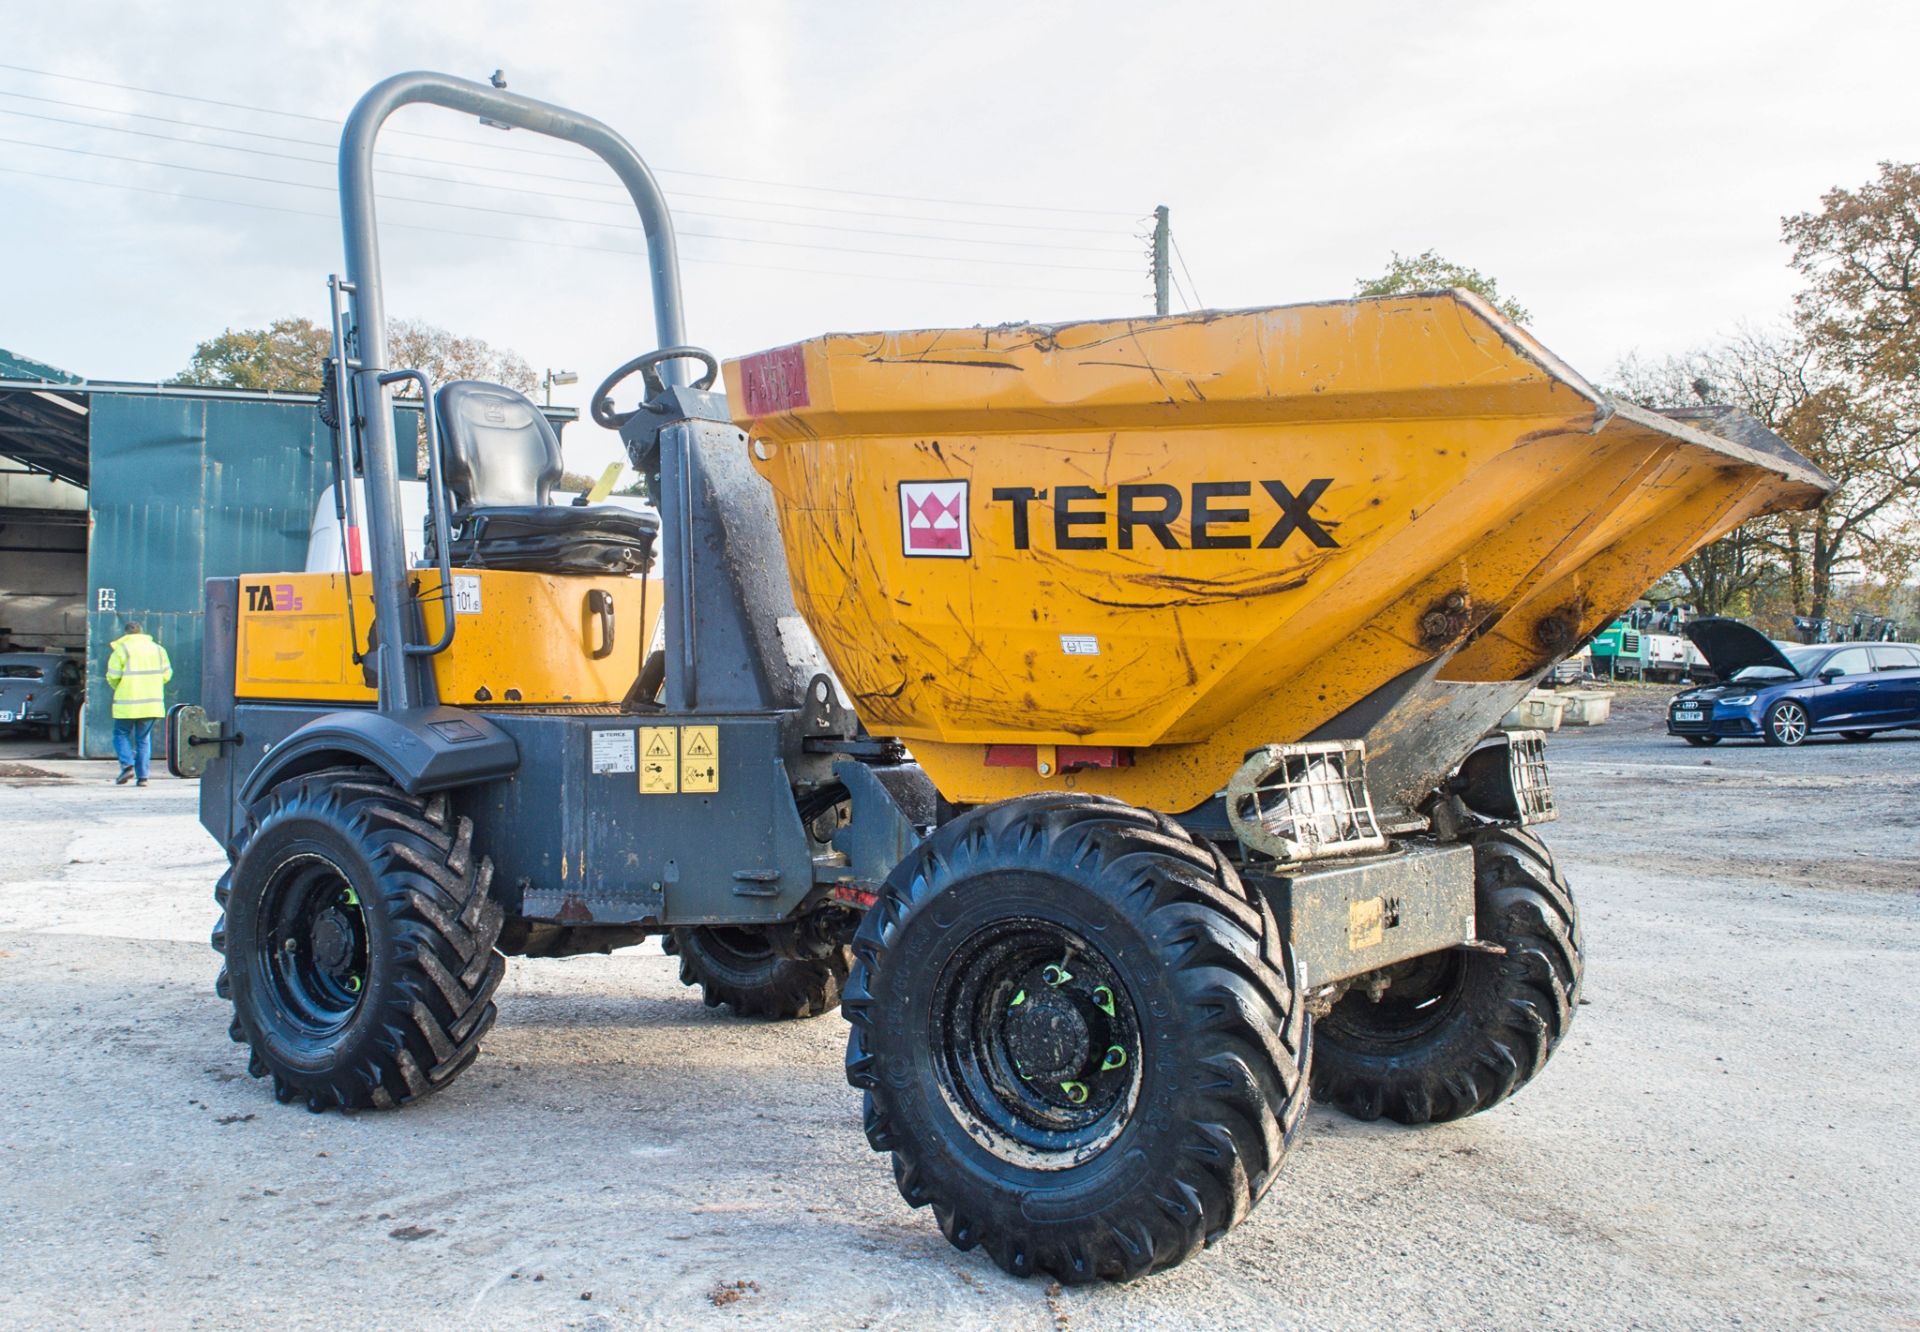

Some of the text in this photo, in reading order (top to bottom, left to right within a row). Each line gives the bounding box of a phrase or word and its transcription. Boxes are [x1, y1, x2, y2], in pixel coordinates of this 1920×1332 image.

[992, 478, 1342, 550] TEREX
[245, 584, 304, 612] TA3s
[457, 591, 471, 610] 101
